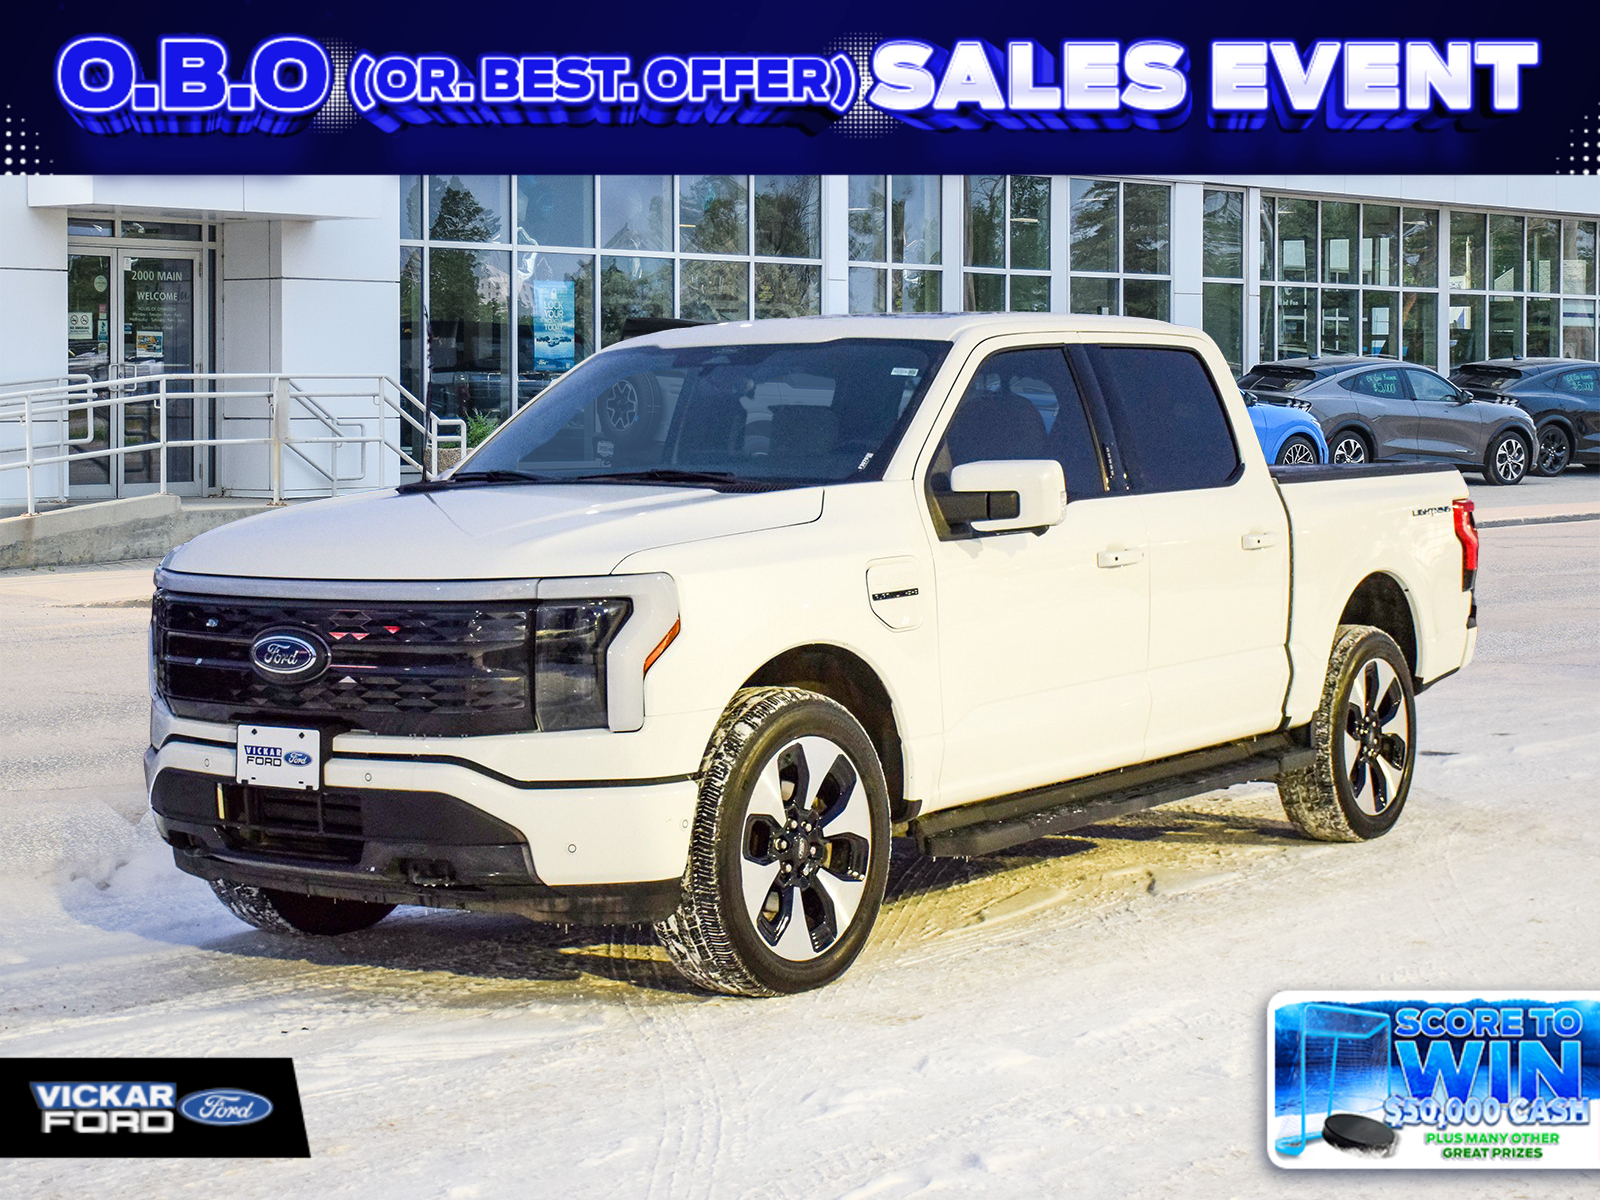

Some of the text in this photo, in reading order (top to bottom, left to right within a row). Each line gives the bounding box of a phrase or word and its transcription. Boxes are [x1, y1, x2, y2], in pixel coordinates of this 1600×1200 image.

[131, 271, 182, 281] 2000 MAIN
[136, 291, 178, 301] WELCOME
[544, 310, 565, 319] YOUR
[264, 643, 299, 665] Ford
[245, 746, 282, 757] VICKAR
[246, 756, 282, 767] FORD
[288, 752, 307, 765] Ford
